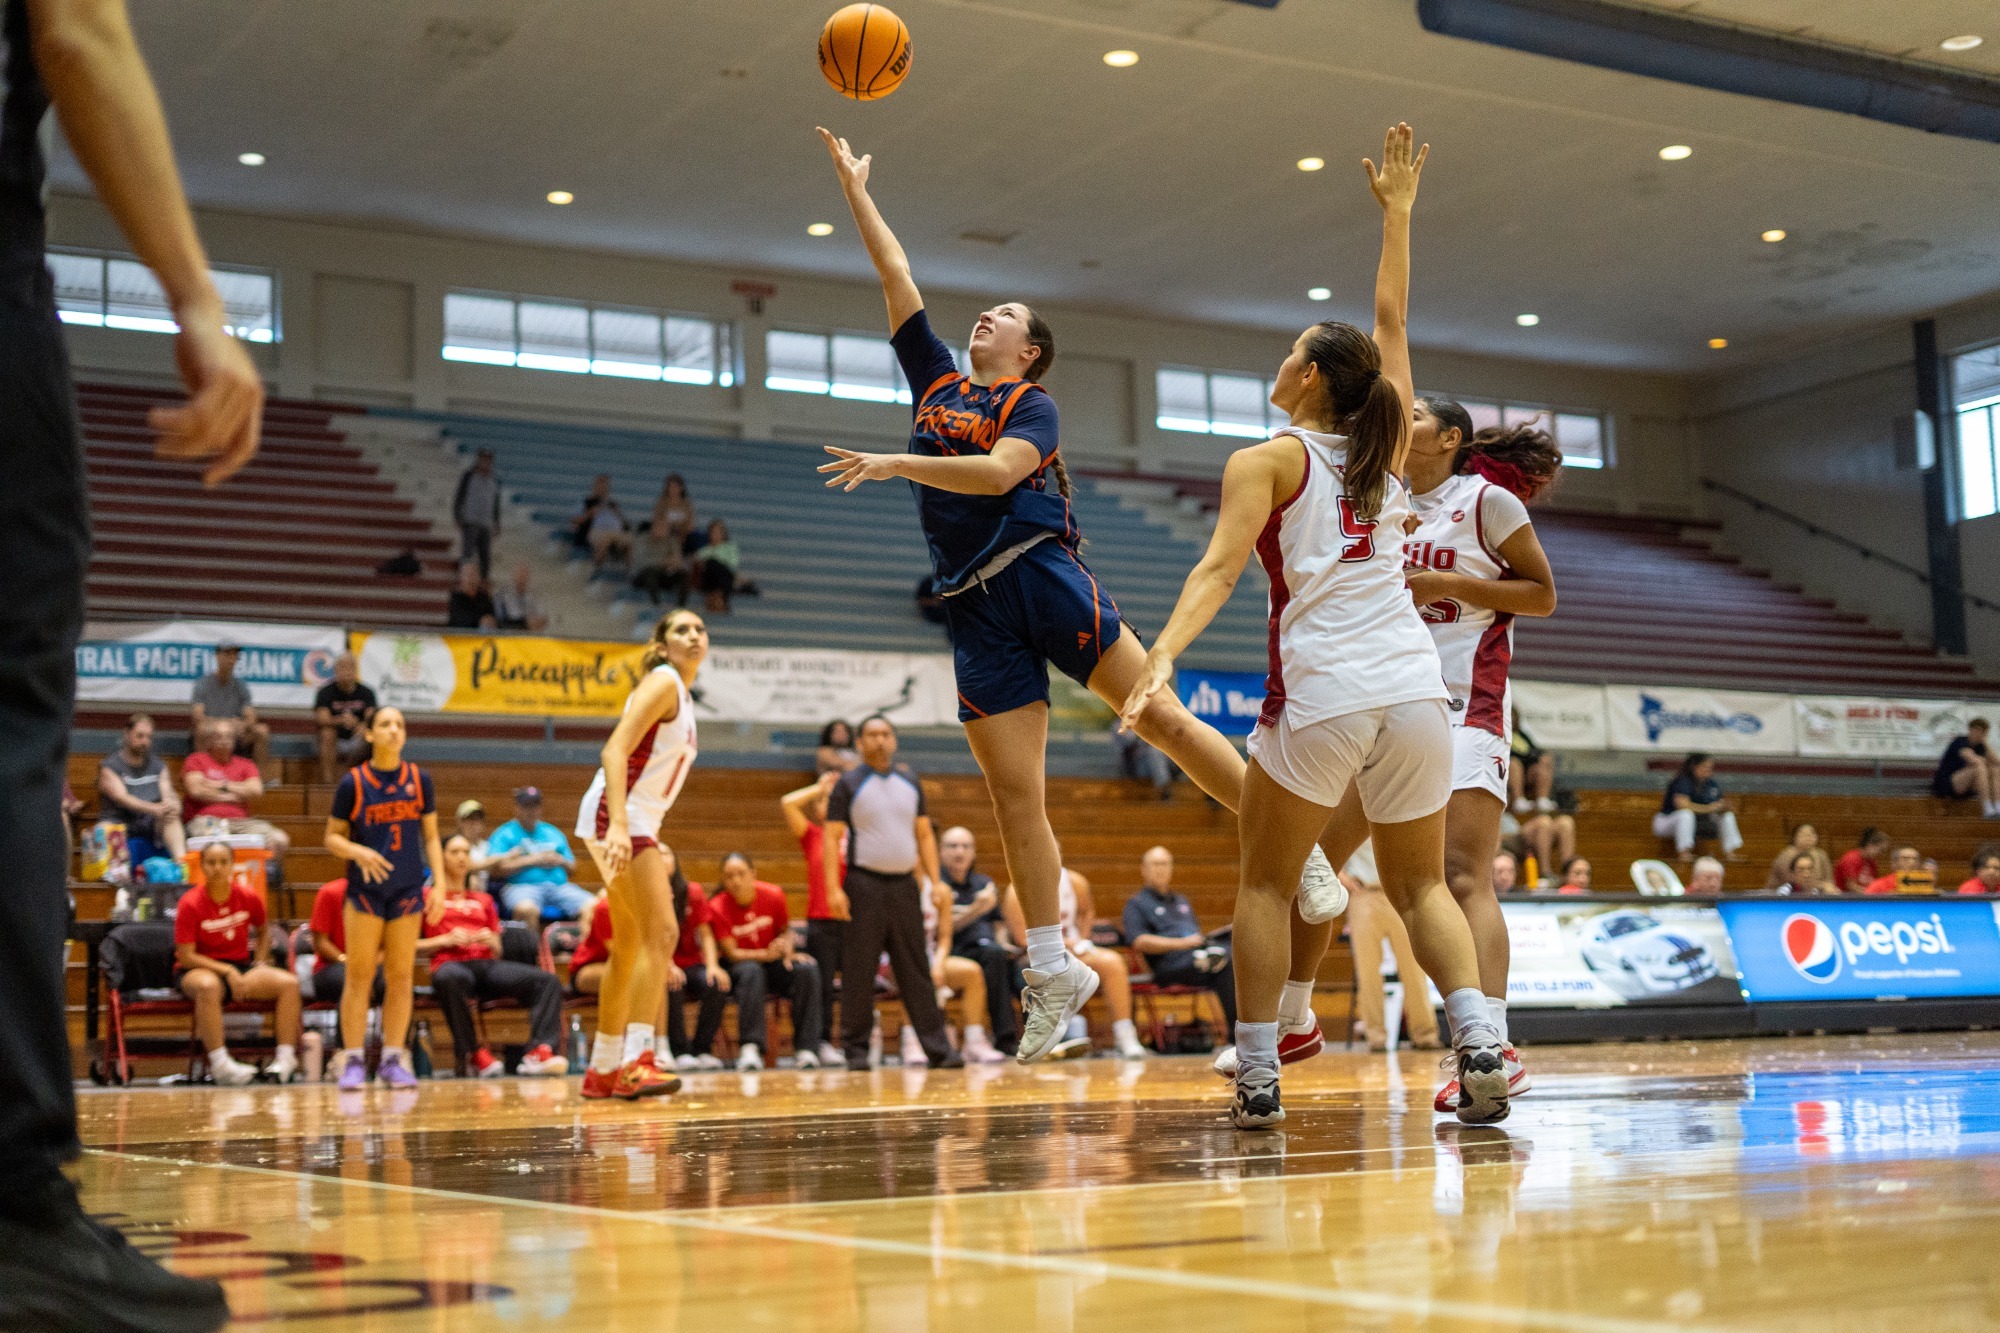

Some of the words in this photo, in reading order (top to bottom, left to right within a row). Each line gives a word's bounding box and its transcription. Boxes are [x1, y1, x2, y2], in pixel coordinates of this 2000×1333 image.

[914, 404, 996, 451] FRESNO
[1336, 495, 1379, 563] 5
[389, 823, 402, 852] 3
[1839, 912, 1951, 965] pepsi
